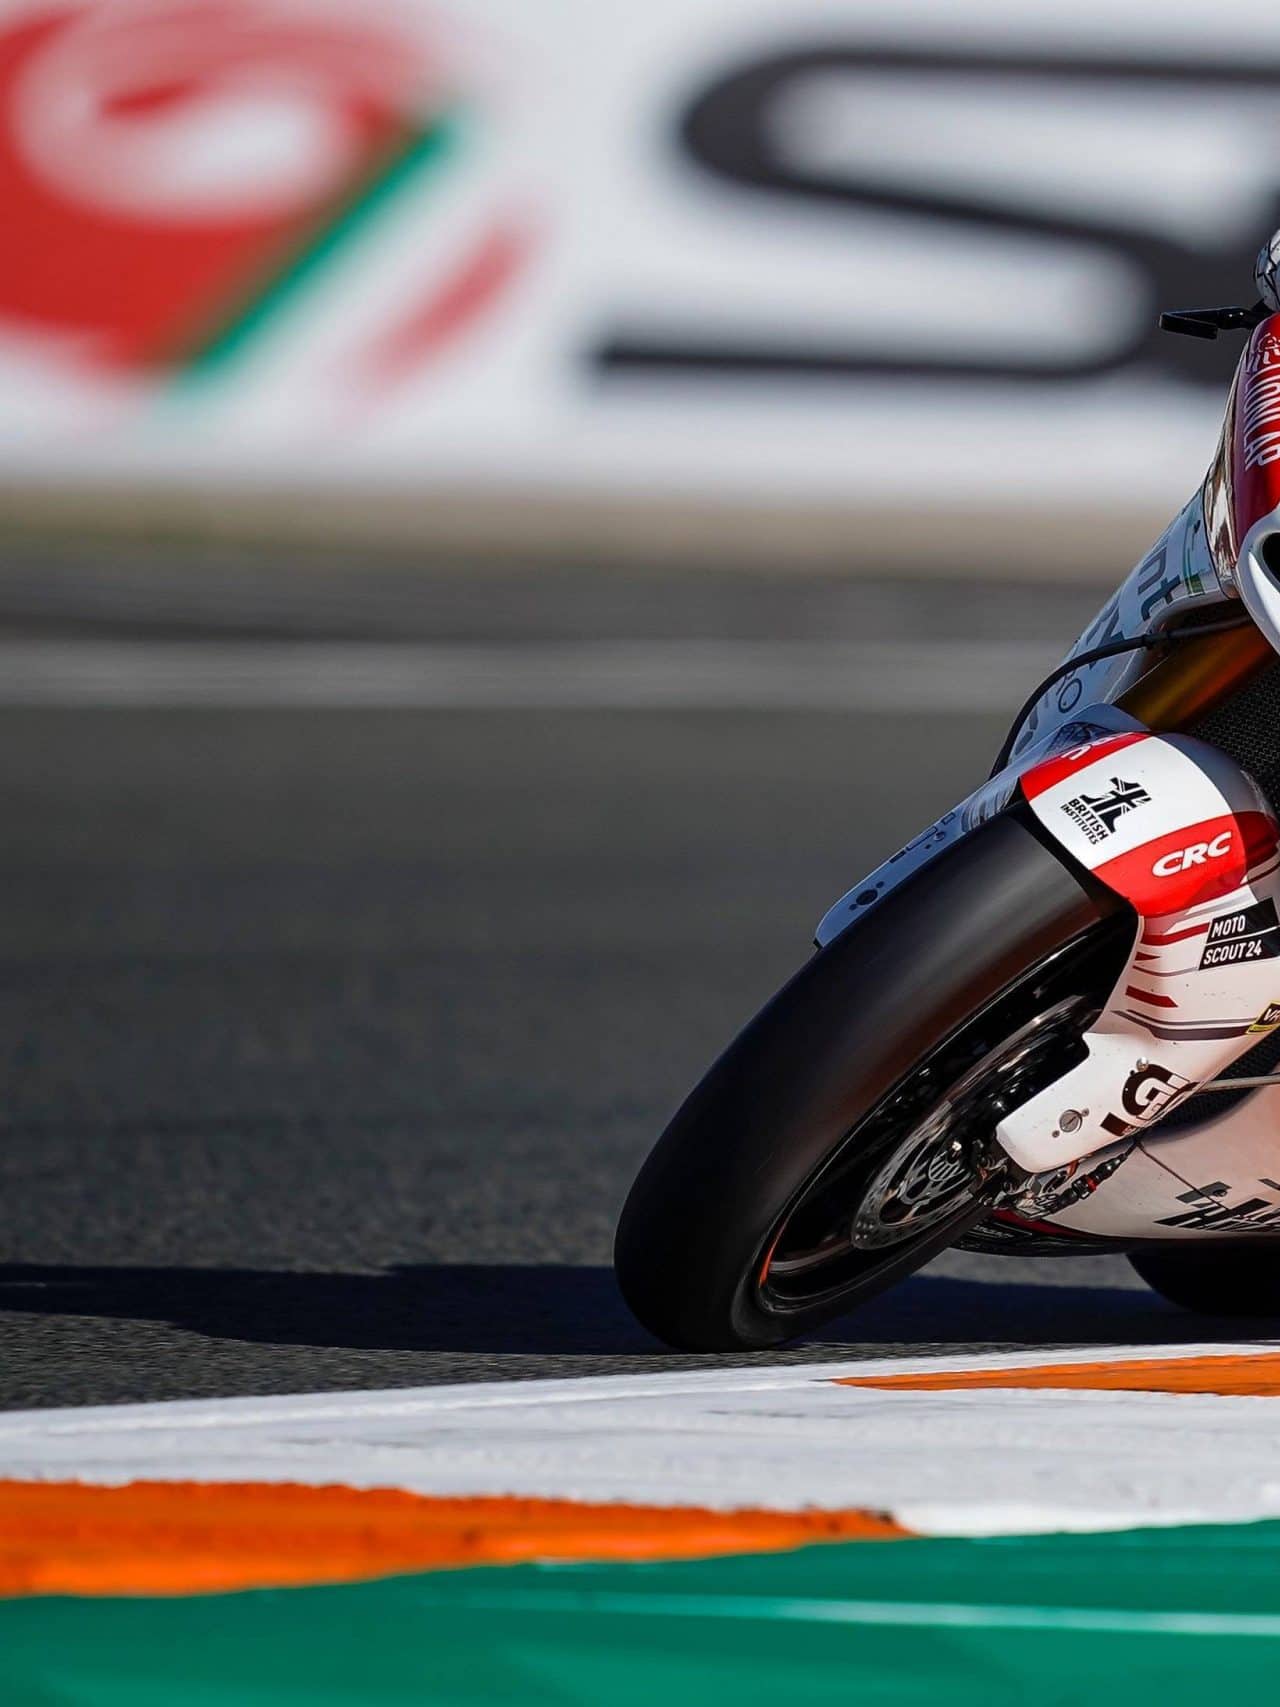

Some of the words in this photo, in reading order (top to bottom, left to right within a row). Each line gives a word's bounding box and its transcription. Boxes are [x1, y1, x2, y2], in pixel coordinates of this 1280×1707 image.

[1059, 803, 1099, 846] INSTITUTES
[1068, 797, 1110, 842] BRITISH
[1151, 830, 1233, 879] CRC
[1210, 913, 1247, 939] MOTO
